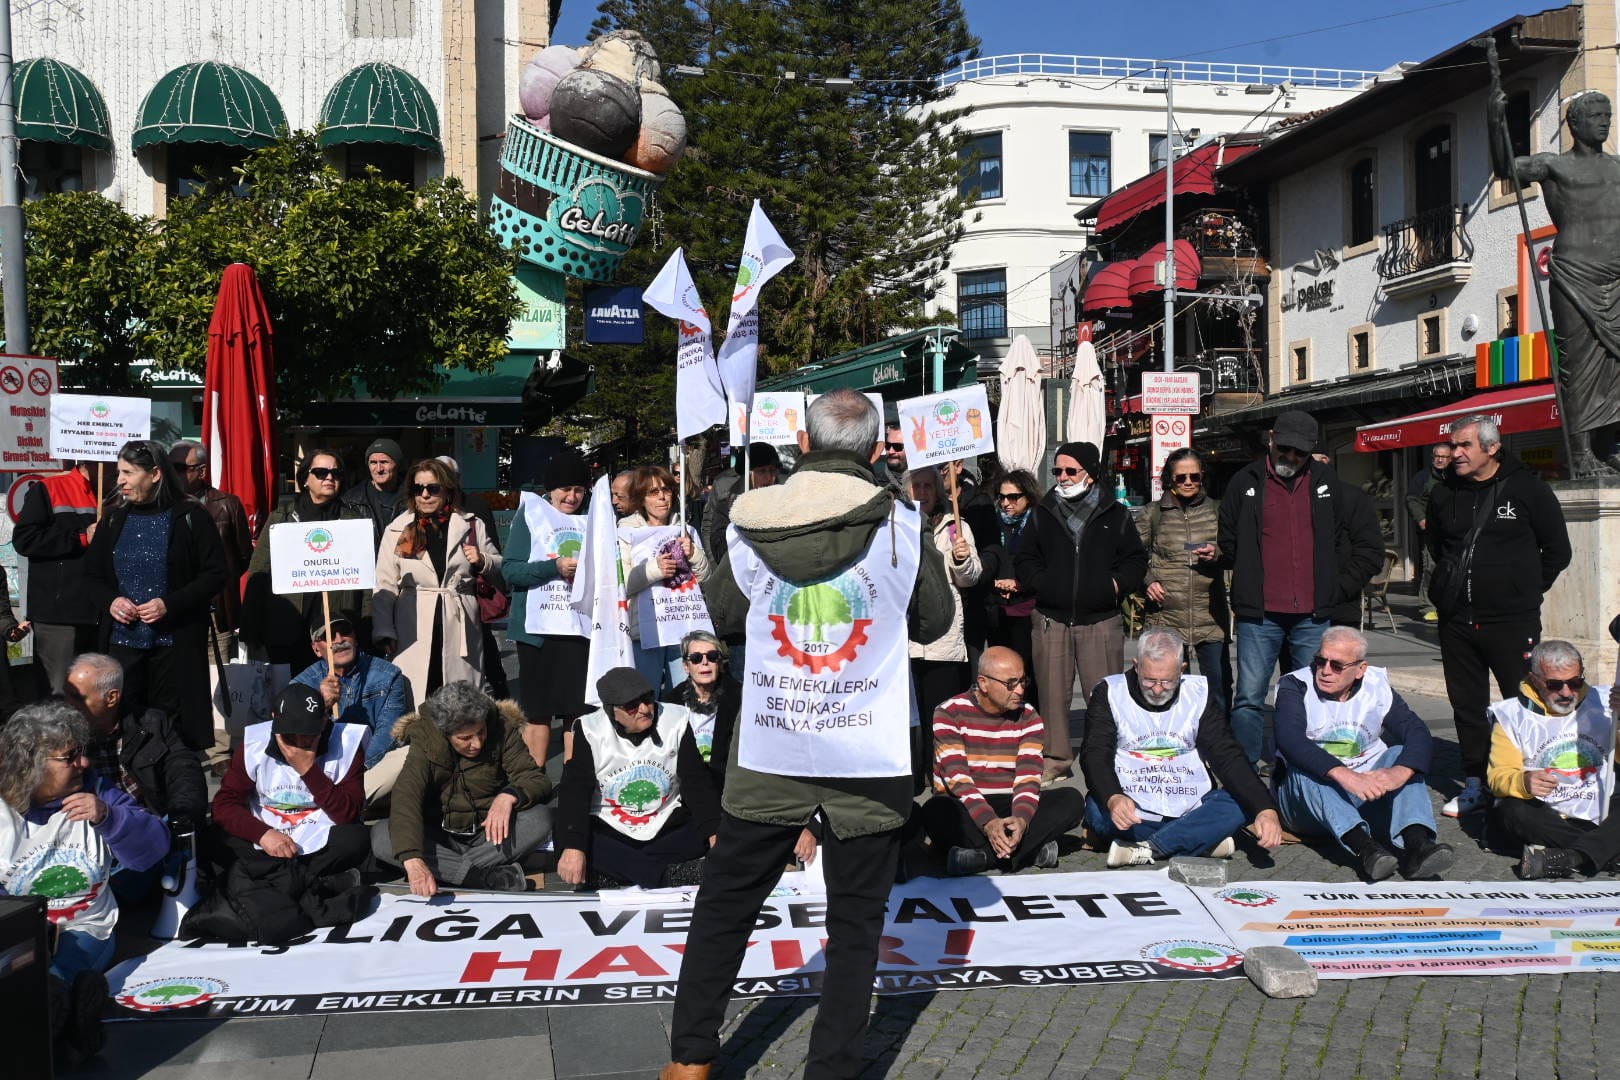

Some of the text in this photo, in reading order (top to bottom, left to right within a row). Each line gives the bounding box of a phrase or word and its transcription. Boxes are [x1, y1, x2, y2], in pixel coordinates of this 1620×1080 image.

[591, 304, 640, 319] LAVAZZA
[303, 558, 340, 567] ONURLU
[291, 566, 360, 578] BİR YAŞAM İÇİN
[292, 577, 361, 588] ALANLARDAYIZ
[804, 643, 829, 653] 2017
[752, 671, 879, 694] TÜM EMEKLİLERİN
[766, 696, 846, 715] SENDİKASI
[754, 711, 873, 732] ANTALYA ŞUBESİ
[1304, 892, 1359, 901] TÜM
[1365, 891, 1531, 901] EMEKLİLERİN
[579, 909, 695, 938] VE
[1276, 923, 1324, 931] Açlığa
[1328, 922, 1388, 930] sefalete
[1391, 920, 1438, 928] teslim
[1413, 944, 1485, 953] emekliye
[1312, 962, 1392, 971] oksulluğa
[1420, 959, 1496, 967] karanlığa
[211, 996, 297, 1013] TÜM
[315, 986, 582, 1011] EMEKLİLERİN
